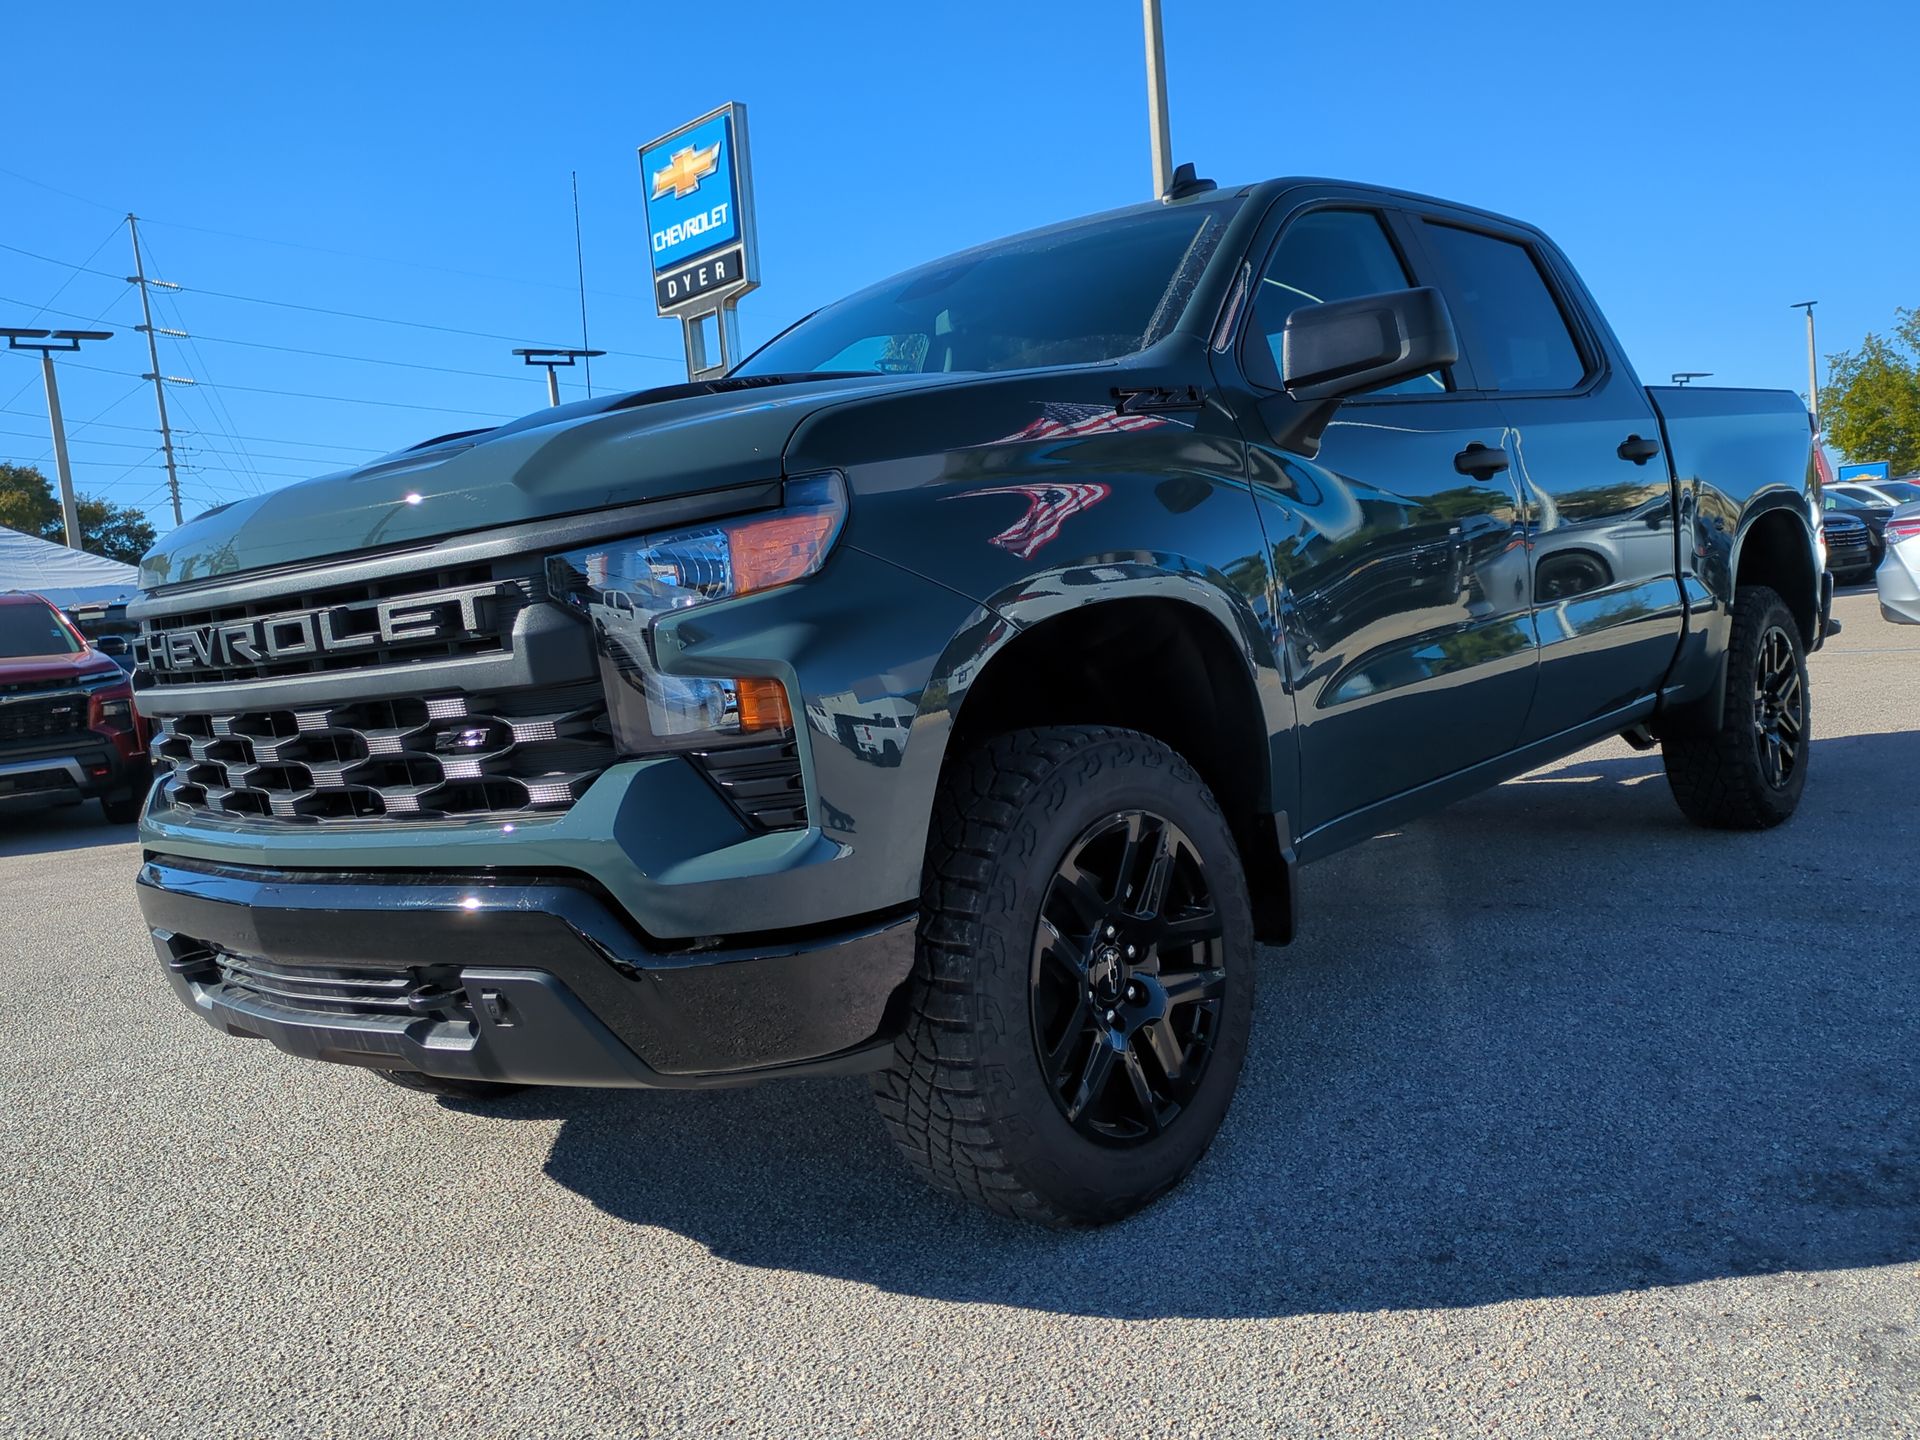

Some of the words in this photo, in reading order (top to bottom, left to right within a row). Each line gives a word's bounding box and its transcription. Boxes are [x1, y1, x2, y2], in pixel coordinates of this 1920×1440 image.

[653, 203, 728, 252] CHEVROLET
[667, 261, 726, 299] DYER
[131, 586, 498, 670] CHEVROLET
